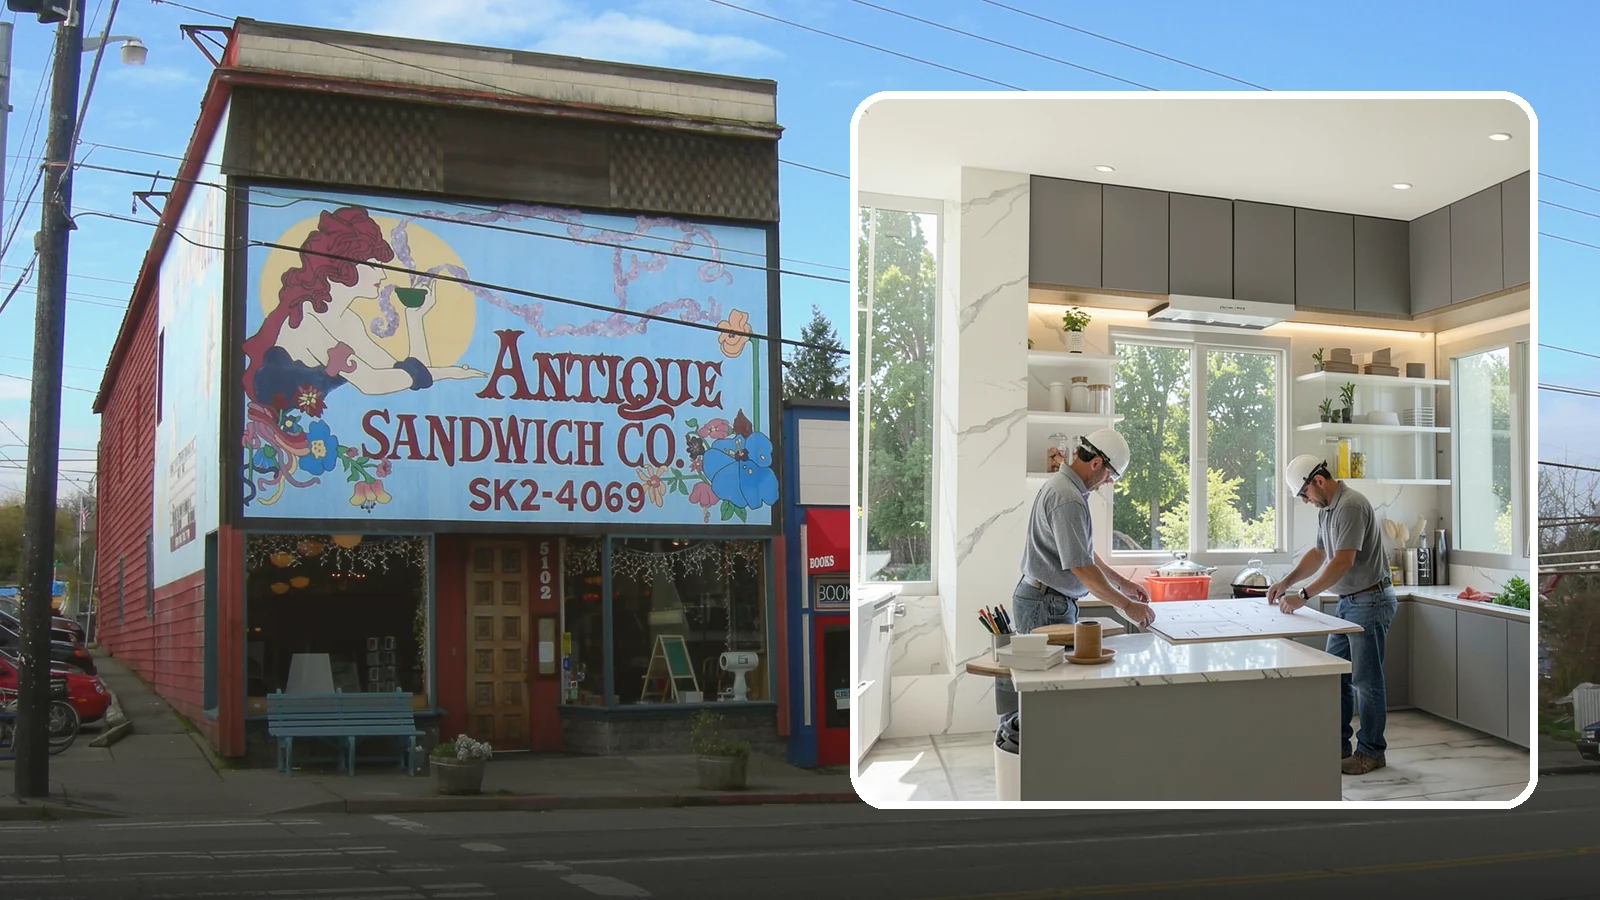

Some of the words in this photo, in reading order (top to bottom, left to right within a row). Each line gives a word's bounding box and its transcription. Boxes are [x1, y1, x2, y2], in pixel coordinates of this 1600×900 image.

[475, 329, 724, 421] ANTIQUE
[361, 408, 605, 468] SANDWICH
[616, 421, 685, 469] CO.
[467, 476, 646, 513] SK2-4069
[539, 541, 552, 600] 5102
[809, 555, 835, 569] BOOKS
